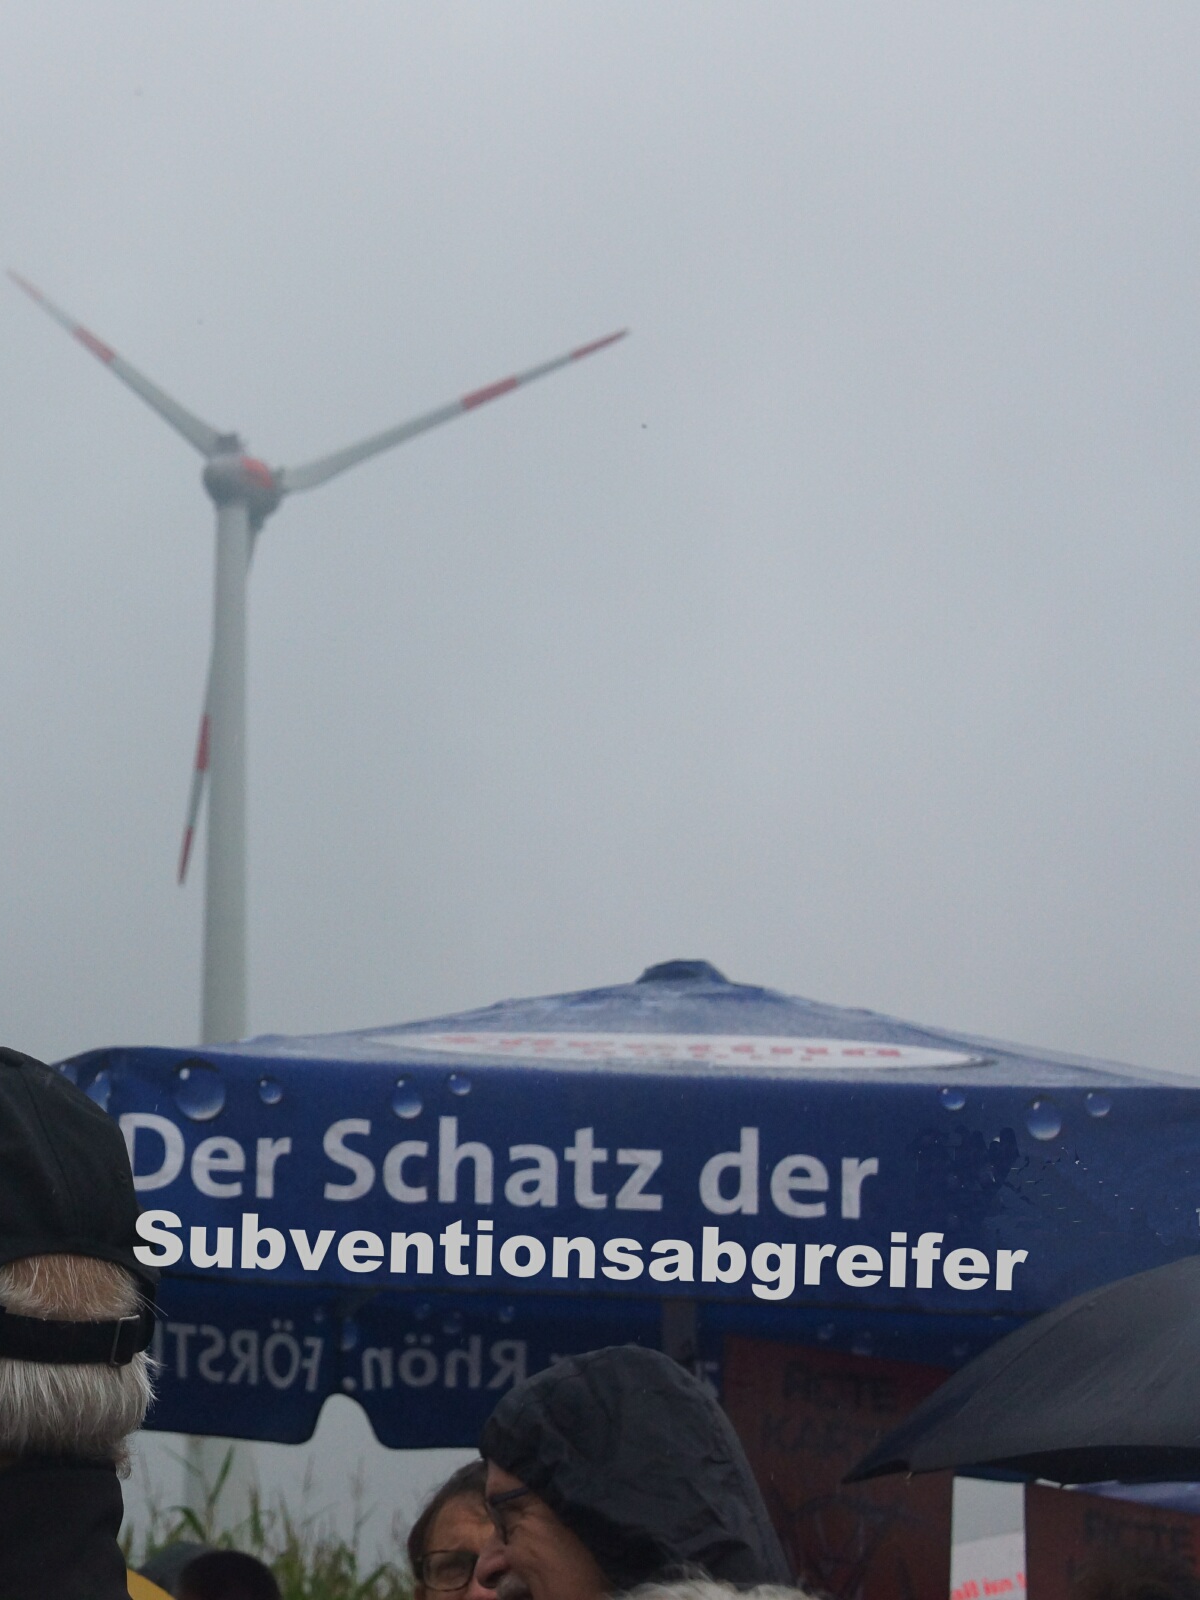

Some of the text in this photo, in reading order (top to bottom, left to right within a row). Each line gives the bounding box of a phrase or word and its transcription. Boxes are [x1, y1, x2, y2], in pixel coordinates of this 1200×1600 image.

[119, 1112, 878, 1220] Der Schatz der
